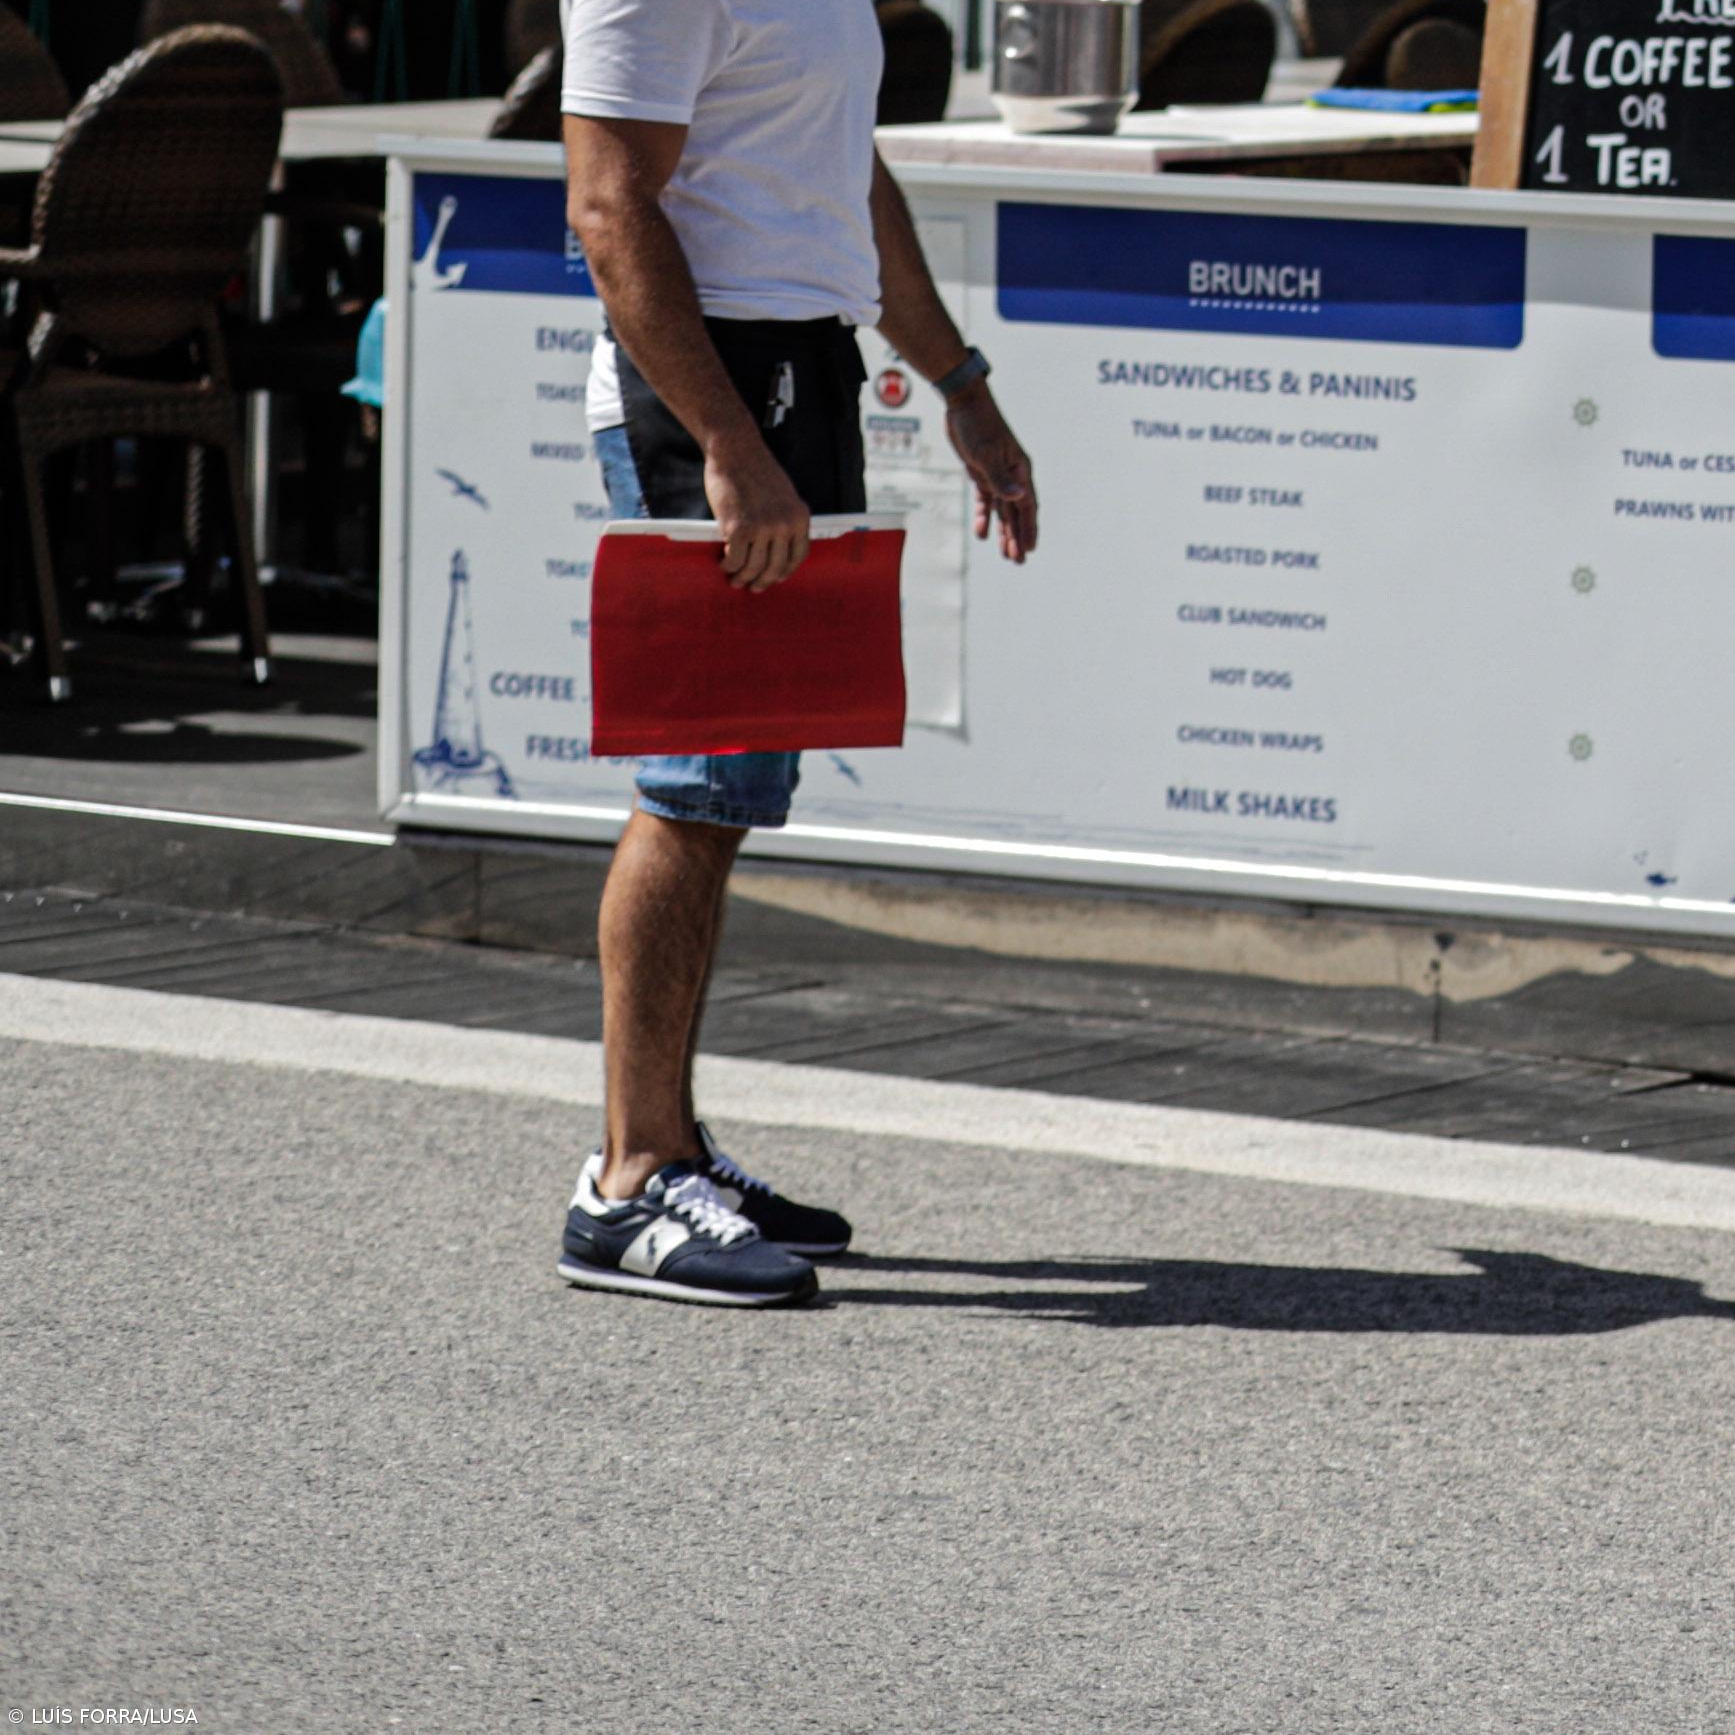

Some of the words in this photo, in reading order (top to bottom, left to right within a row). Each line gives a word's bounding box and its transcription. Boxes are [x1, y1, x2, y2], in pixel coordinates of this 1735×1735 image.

[1544, 31, 1573, 85] 1
[1619, 92, 1666, 130] OR
[1536, 125, 1568, 183] 1
[1189, 260, 1321, 302] BRUNCH
[1097, 359, 1272, 394] SANDWICHES
[1279, 370, 1300, 395] &
[1309, 371, 1417, 402] PANINIS
[1132, 419, 1182, 438] TUNA
[1186, 427, 1205, 440] or
[1209, 424, 1273, 444] BACON
[1276, 432, 1296, 446] or
[1299, 430, 1379, 451] CHICKEN
[1621, 448, 1674, 468] TUNA
[1678, 457, 1699, 471] or
[1203, 485, 1243, 504] BEEF
[1248, 487, 1303, 507] STEAK
[1614, 498, 1695, 521] PRAWNS
[1185, 543, 1267, 566] ROASTED
[1271, 550, 1319, 569] PORK
[1177, 604, 1223, 624] CLUB
[1227, 607, 1327, 631] SANDWICH
[490, 672, 574, 702] COFFEE
[1209, 668, 1247, 685] HOT
[1252, 670, 1293, 690] DOG
[1177, 724, 1255, 747] CHICKEN
[1259, 732, 1324, 753] WRAPS
[1167, 786, 1229, 813] MILK
[1237, 791, 1337, 823] SHAKES
